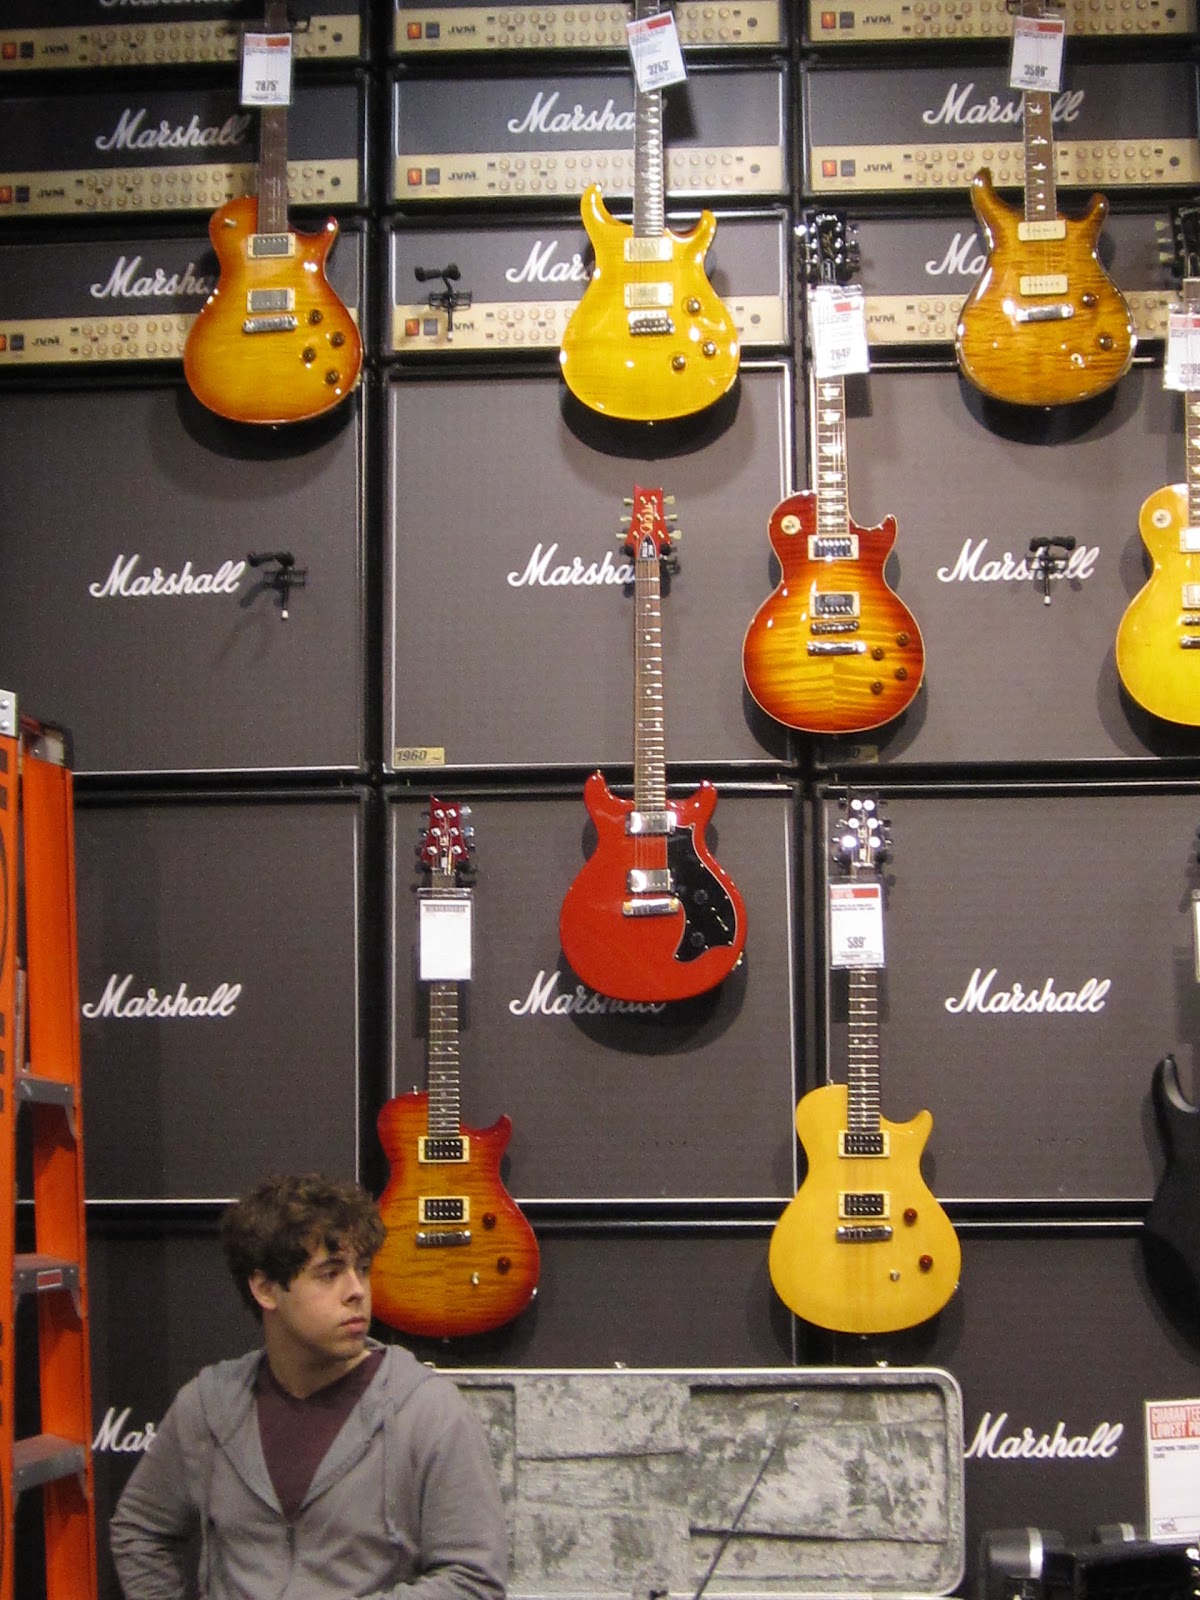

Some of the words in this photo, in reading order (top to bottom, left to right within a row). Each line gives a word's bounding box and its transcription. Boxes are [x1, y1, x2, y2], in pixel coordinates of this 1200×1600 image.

[448, 24, 476, 35] JVM
[863, 14, 891, 25] JVM
[507, 91, 636, 132] Marsha
[922, 82, 1085, 125] Marsll
[95, 108, 251, 150] Marshall
[448, 170, 476, 181] JVM
[864, 161, 892, 172] JVM
[90, 256, 210, 297] Marsha
[453, 320, 476, 331] VM
[866, 313, 895, 324] JVM
[89, 554, 246, 597] Marshall
[507, 543, 636, 586] Marsha
[396, 749, 428, 761] 1960
[82, 974, 242, 1018] Marshall
[945, 968, 1111, 1014] Marshall
[964, 1412, 1124, 1458] Marshall
